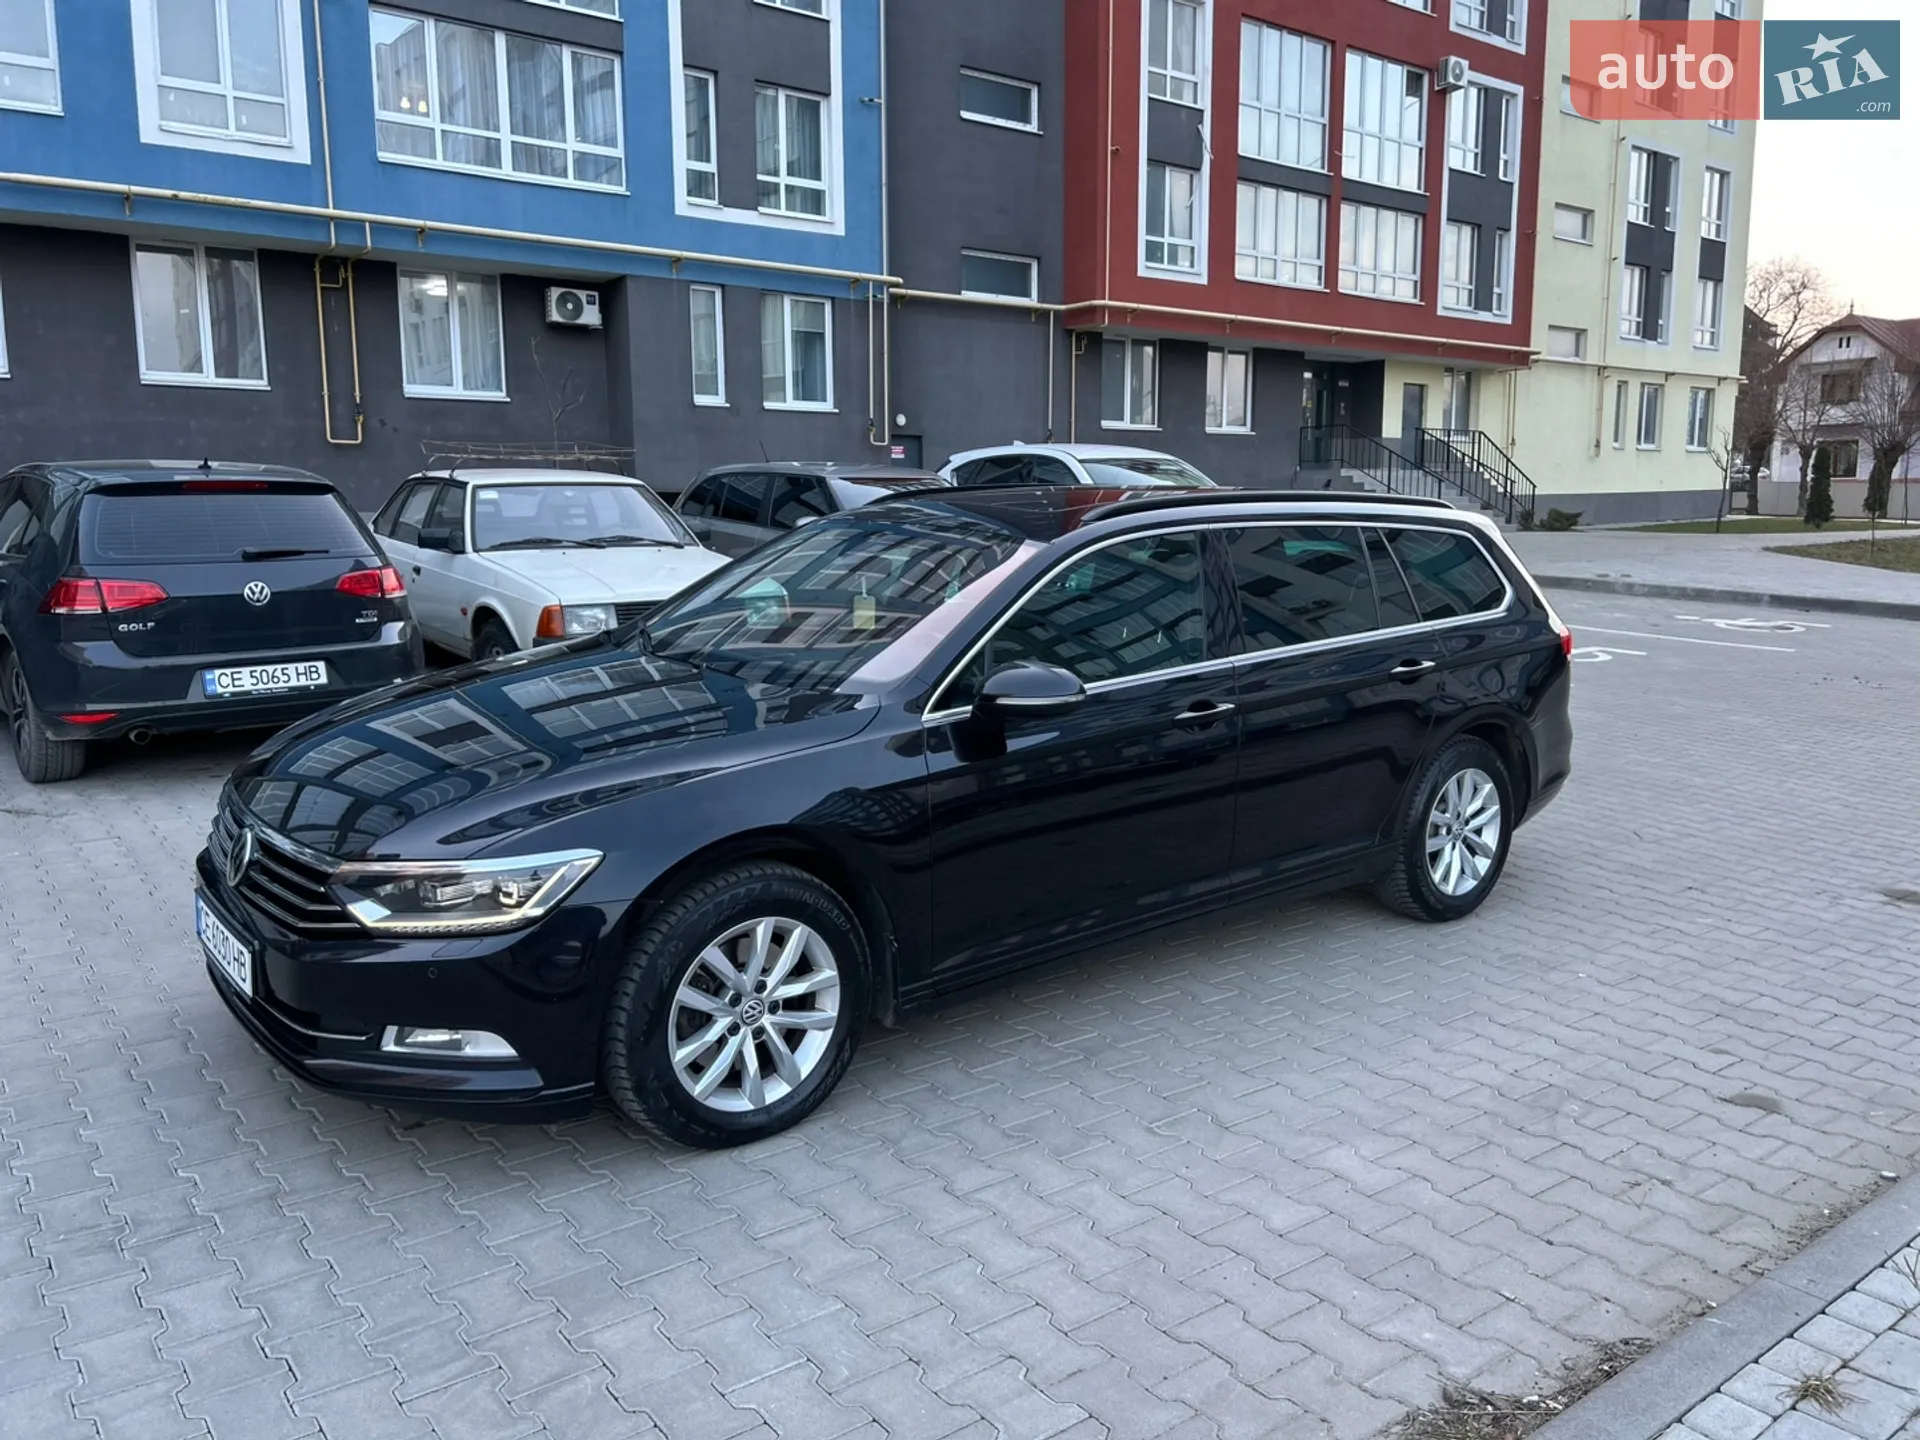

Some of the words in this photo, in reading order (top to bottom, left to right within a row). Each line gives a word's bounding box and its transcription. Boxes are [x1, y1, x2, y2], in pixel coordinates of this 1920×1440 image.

[118, 622, 156, 632] GOLF
[217, 670, 245, 689] CE
[249, 667, 291, 687] 5065
[295, 664, 321, 683] HB
[232, 941, 247, 984] HB
